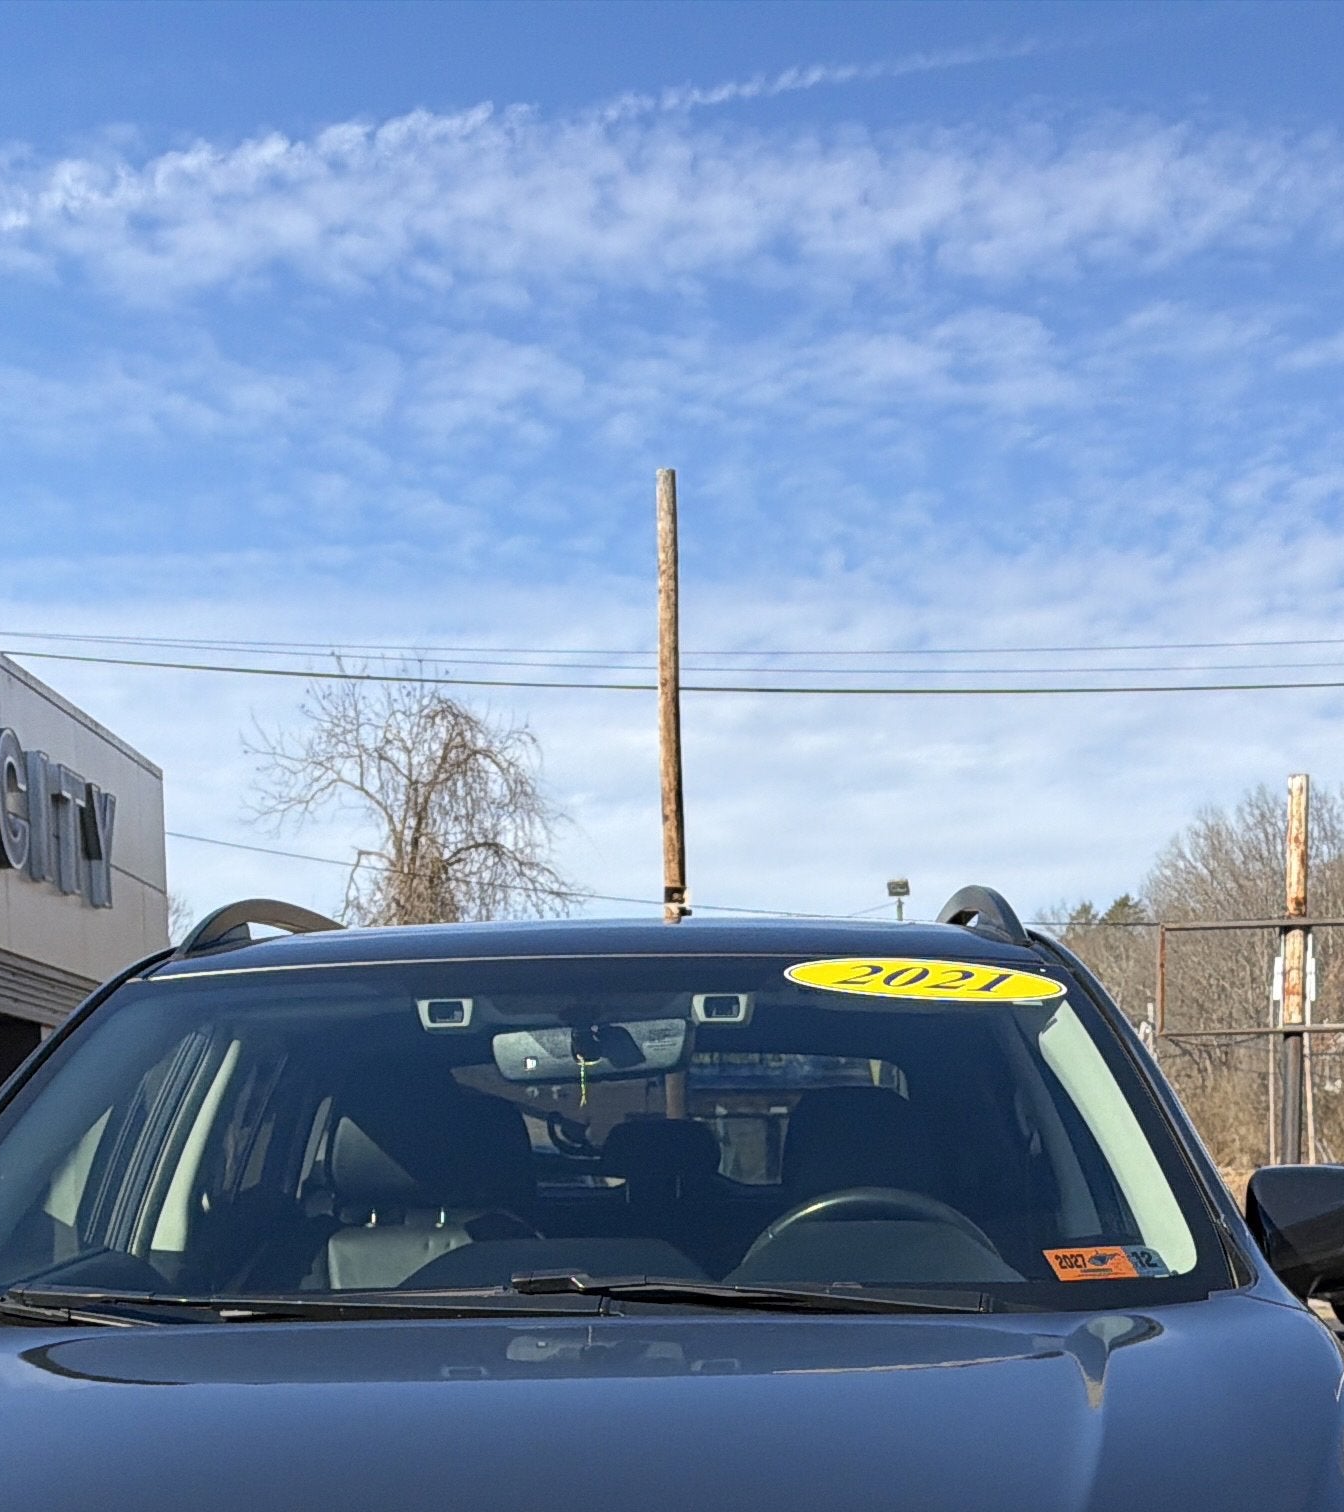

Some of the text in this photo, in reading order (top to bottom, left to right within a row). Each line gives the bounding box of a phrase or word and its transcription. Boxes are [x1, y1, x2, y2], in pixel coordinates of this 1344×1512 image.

[831, 964, 1013, 993] 2021
[1054, 1253, 1087, 1270] 2027
[1131, 1250, 1159, 1268] 12
